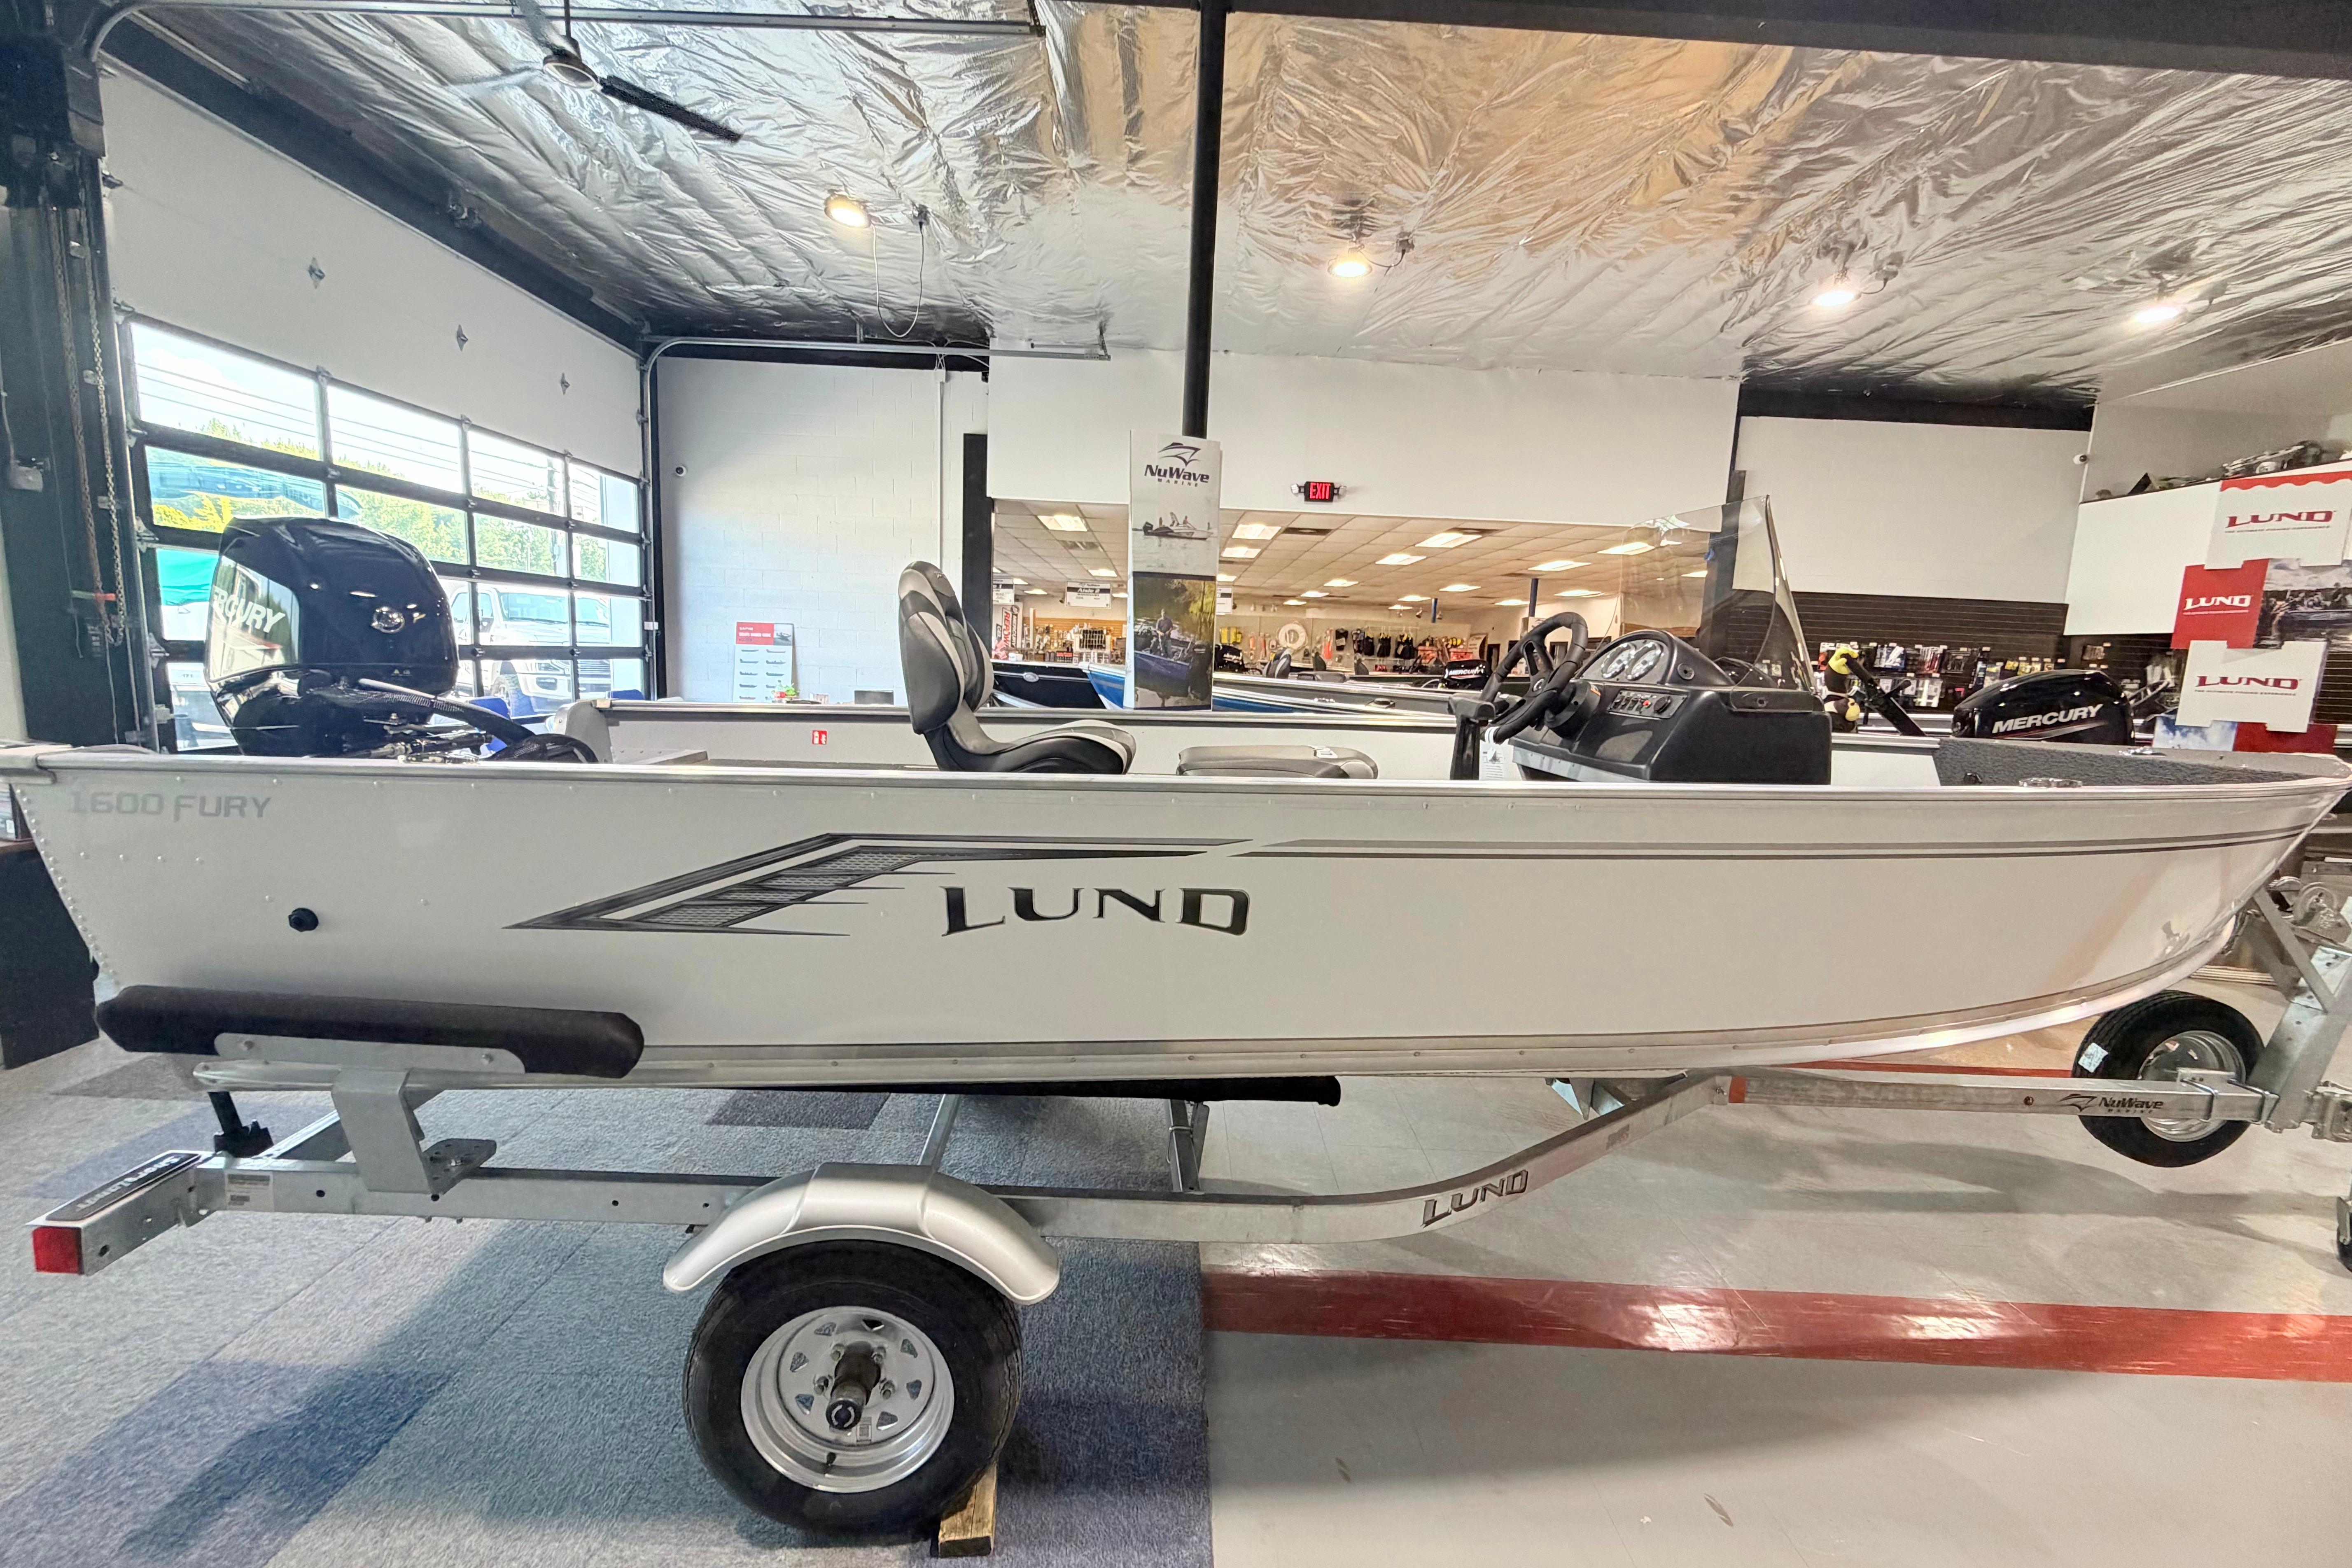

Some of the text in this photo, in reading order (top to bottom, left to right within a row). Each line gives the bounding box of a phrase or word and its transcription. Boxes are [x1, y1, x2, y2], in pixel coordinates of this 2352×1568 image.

[1144, 464, 1209, 483] NuWave
[1157, 478, 1198, 487] MARINE
[1309, 483, 1331, 499] EXIT
[2225, 511, 2333, 528] LUND
[2184, 595, 2252, 610] LUND
[2196, 676, 2298, 690] LUND
[1992, 704, 2104, 733] MERCURY
[67, 791, 272, 822] 1600 FURY
[939, 886, 1250, 937] LUND
[2099, 1097, 2163, 1108] NuWave
[1421, 1169, 1528, 1228] LUND
